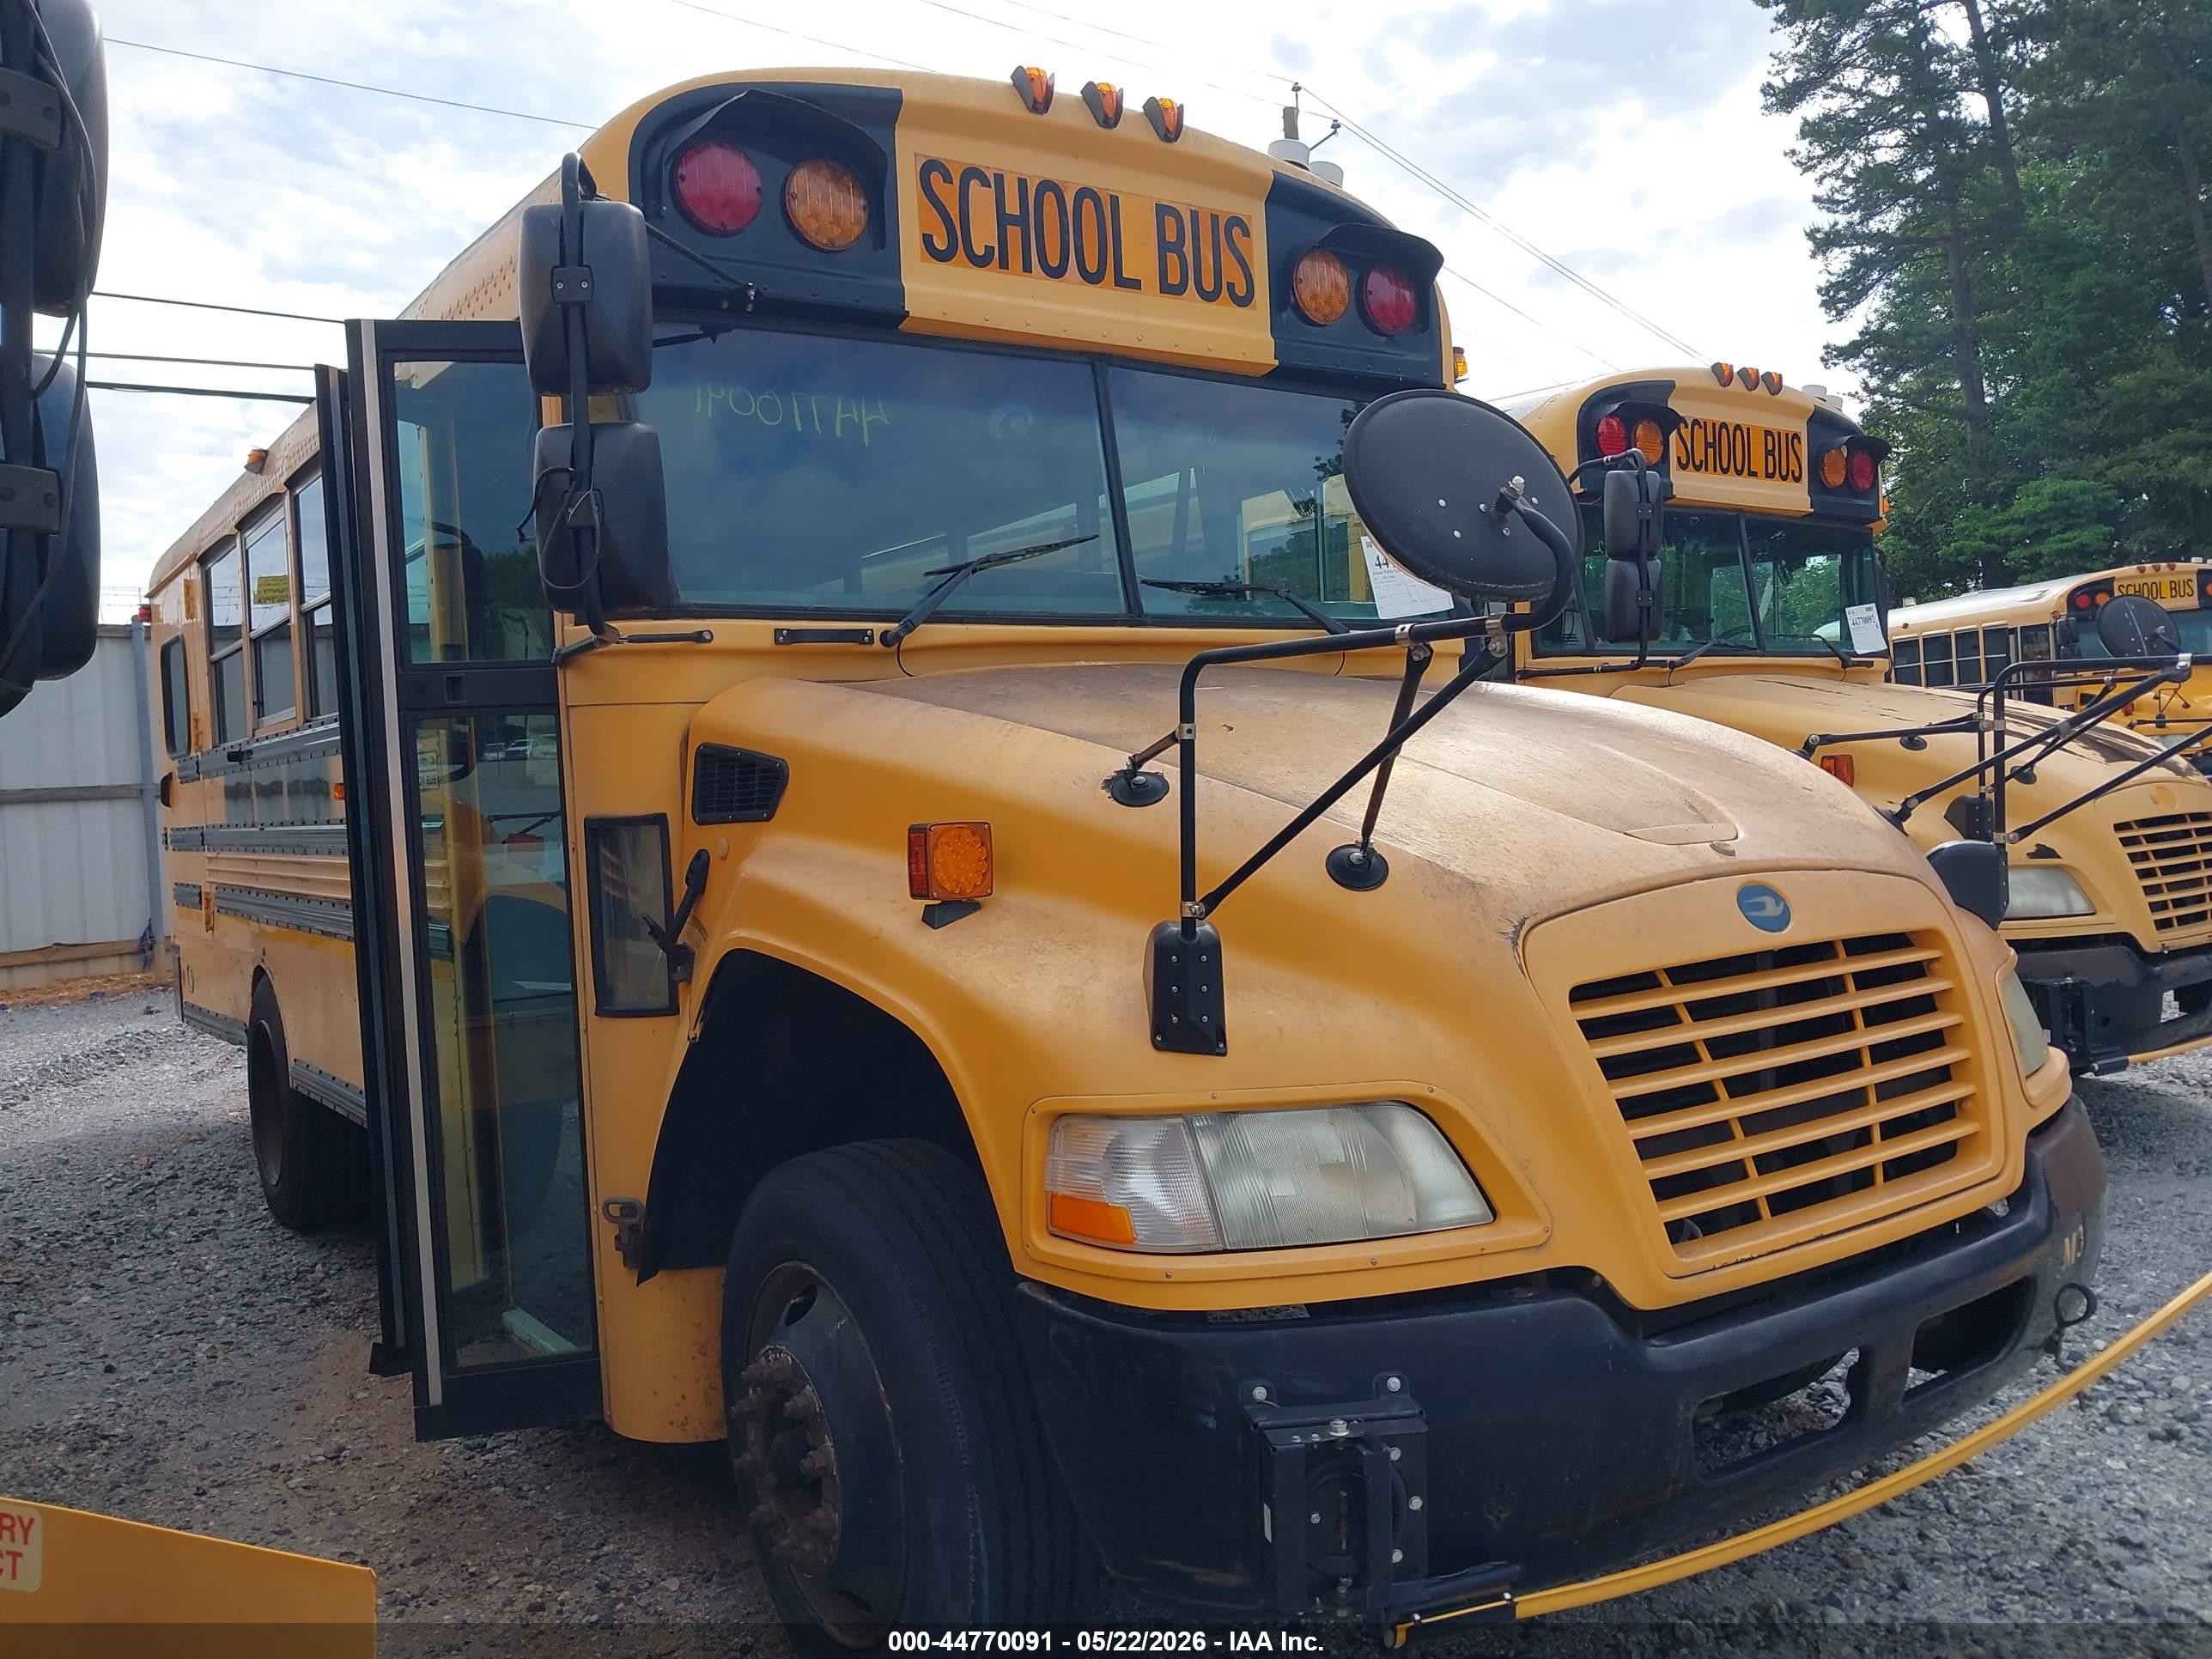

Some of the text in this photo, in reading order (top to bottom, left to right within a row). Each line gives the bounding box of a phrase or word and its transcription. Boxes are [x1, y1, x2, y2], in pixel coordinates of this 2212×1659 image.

[919, 158, 1255, 308] SCHOOL BUS
[1676, 416, 1803, 483] SCHOOL BUS
[2118, 579, 2194, 600] SCHOOL BUS
